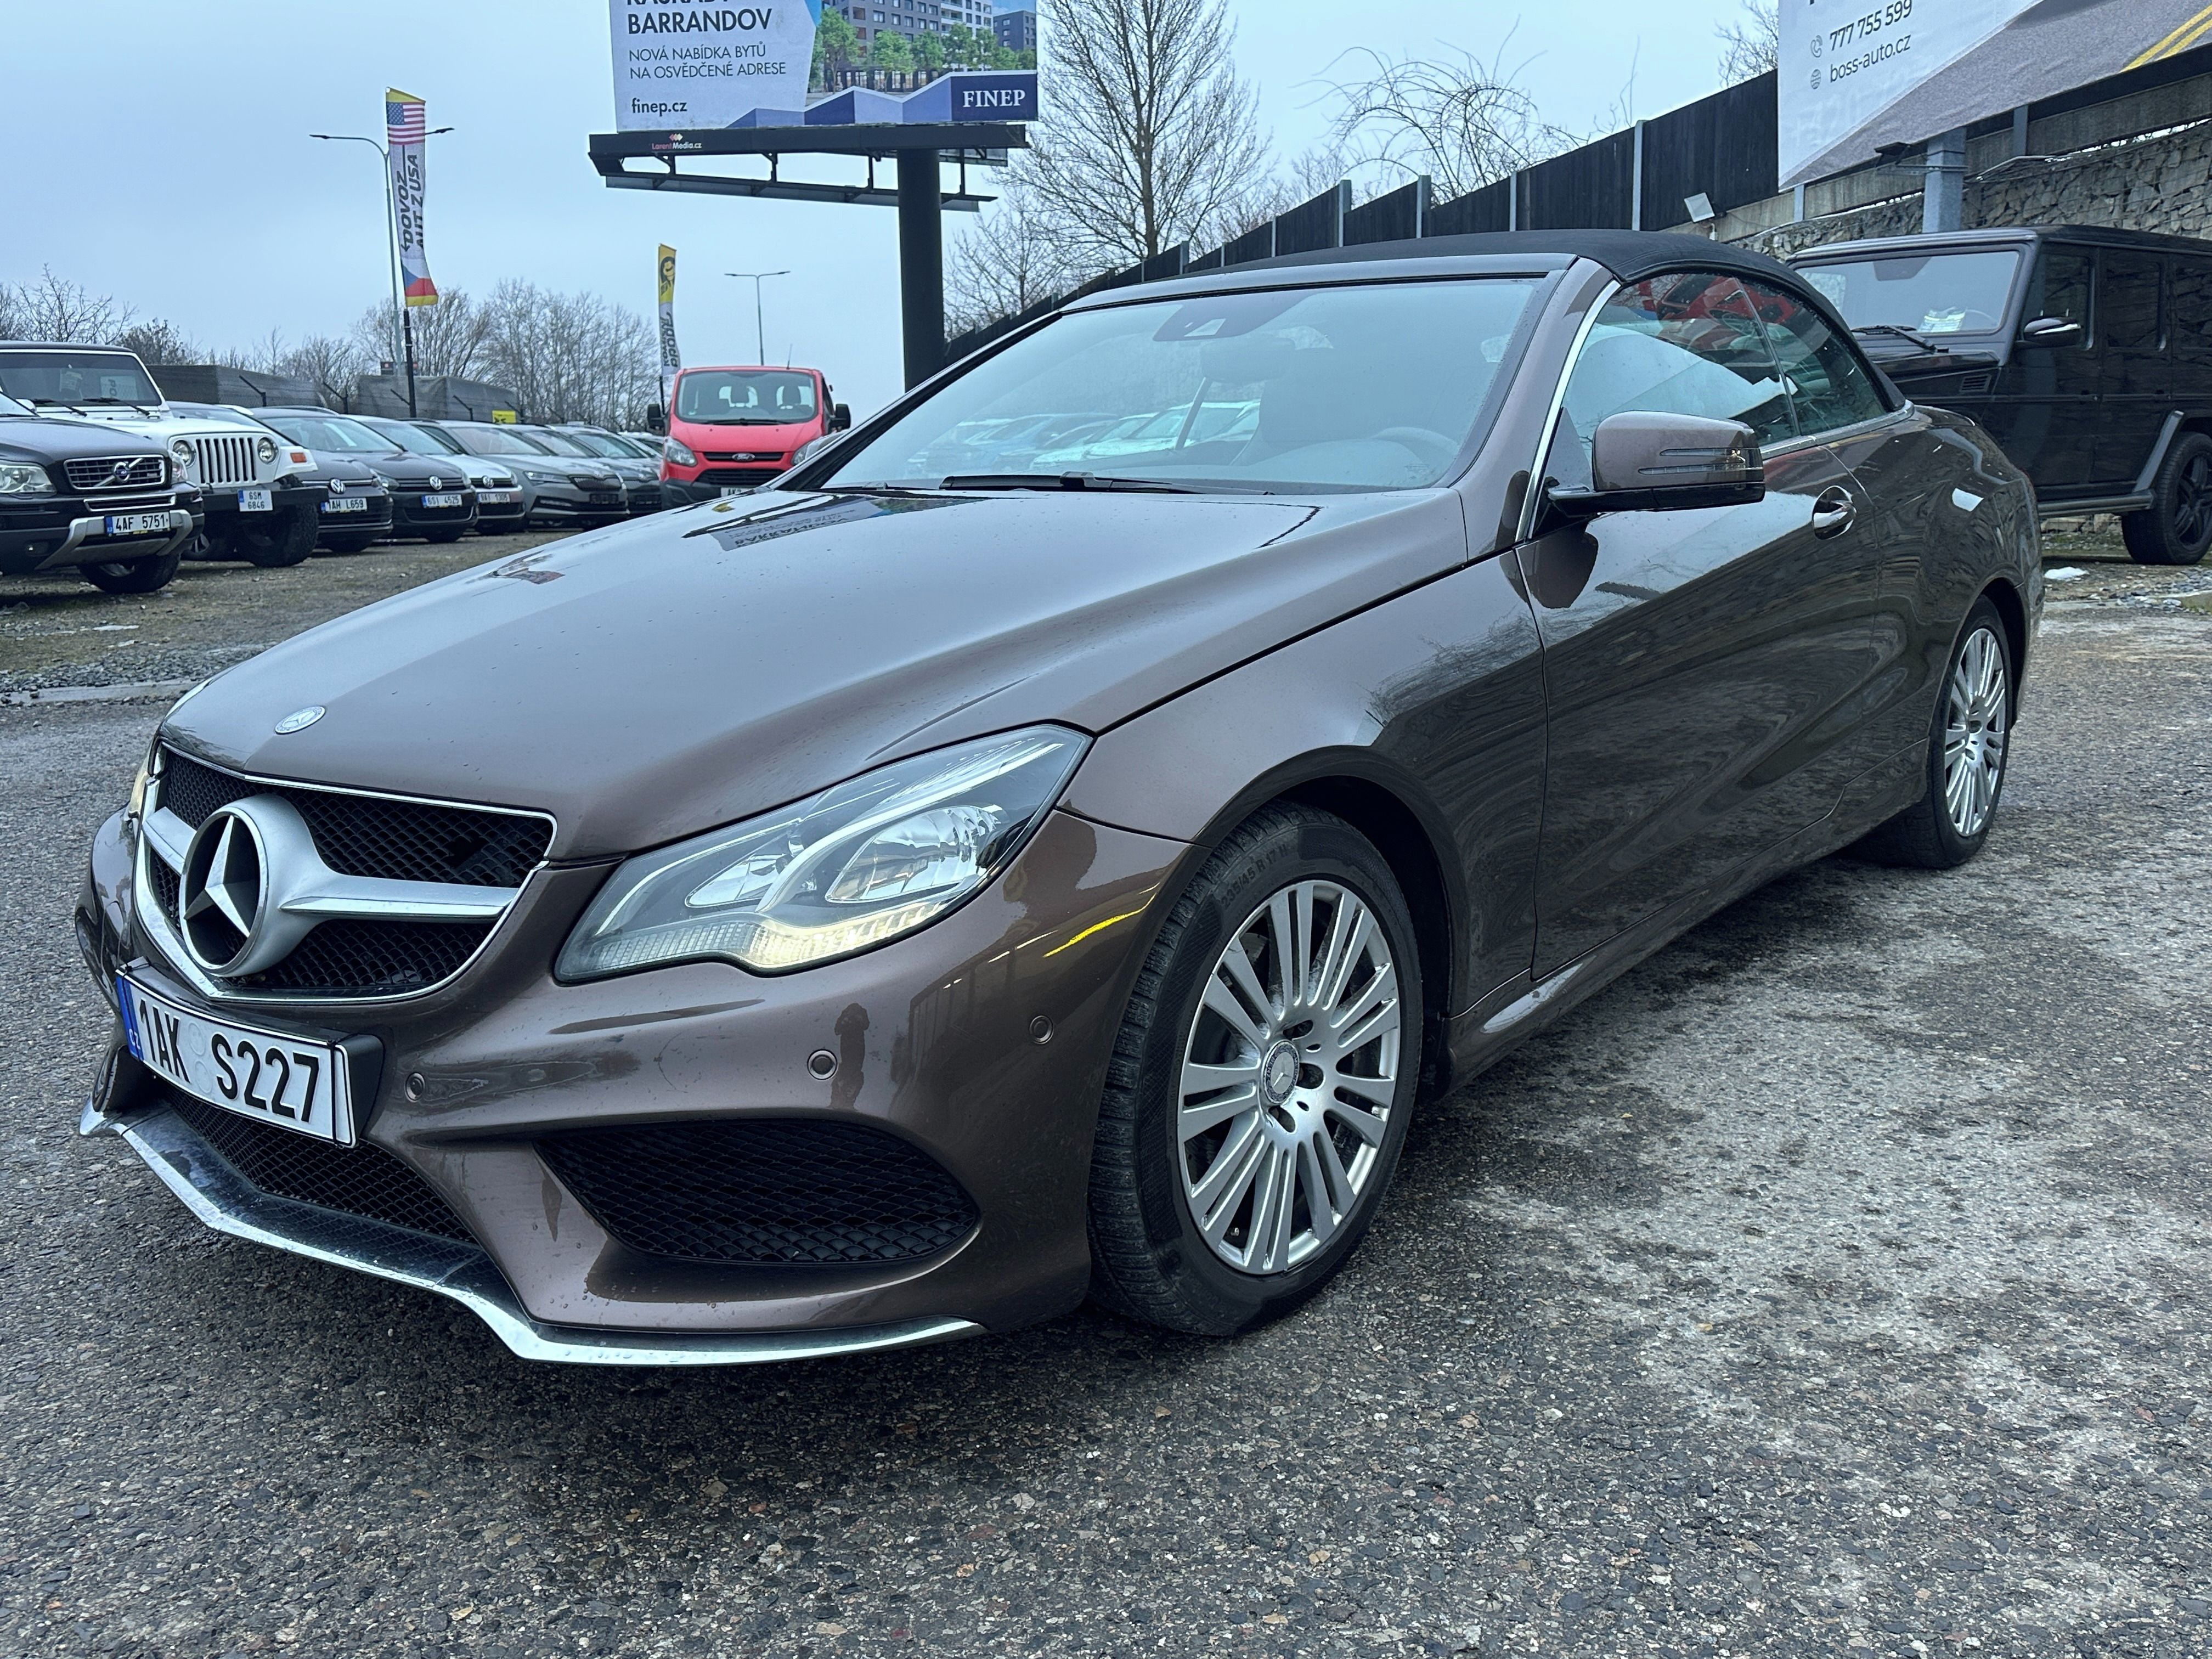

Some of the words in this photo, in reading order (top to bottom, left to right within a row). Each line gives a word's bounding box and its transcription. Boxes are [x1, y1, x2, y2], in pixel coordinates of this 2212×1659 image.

[628, 8, 772, 34] BARRANDOV
[1830, 22, 1854, 51] 777
[1858, 10, 1882, 38] 755
[1885, 0, 1912, 26] 599
[629, 45, 669, 61] NOVÁ
[673, 44, 731, 60] NABÍDKA
[735, 41, 766, 58] BYTŮ
[1830, 35, 1911, 83] boss-auto.cz
[630, 67, 651, 79] NA
[654, 61, 733, 78] OSVĚDČENÉ
[737, 62, 786, 76] ADRESE
[632, 98, 687, 117] finep.cz
[963, 89, 1025, 107] FINEP
[407, 155, 421, 191] USA
[397, 171, 413, 245] DOVOZ
[411, 194, 423, 208] Z
[116, 517, 134, 531] 4AF
[142, 514, 165, 528] 5751
[129, 1028, 140, 1050] CZ
[139, 1000, 190, 1084] 1AK
[212, 1034, 320, 1123] S227
